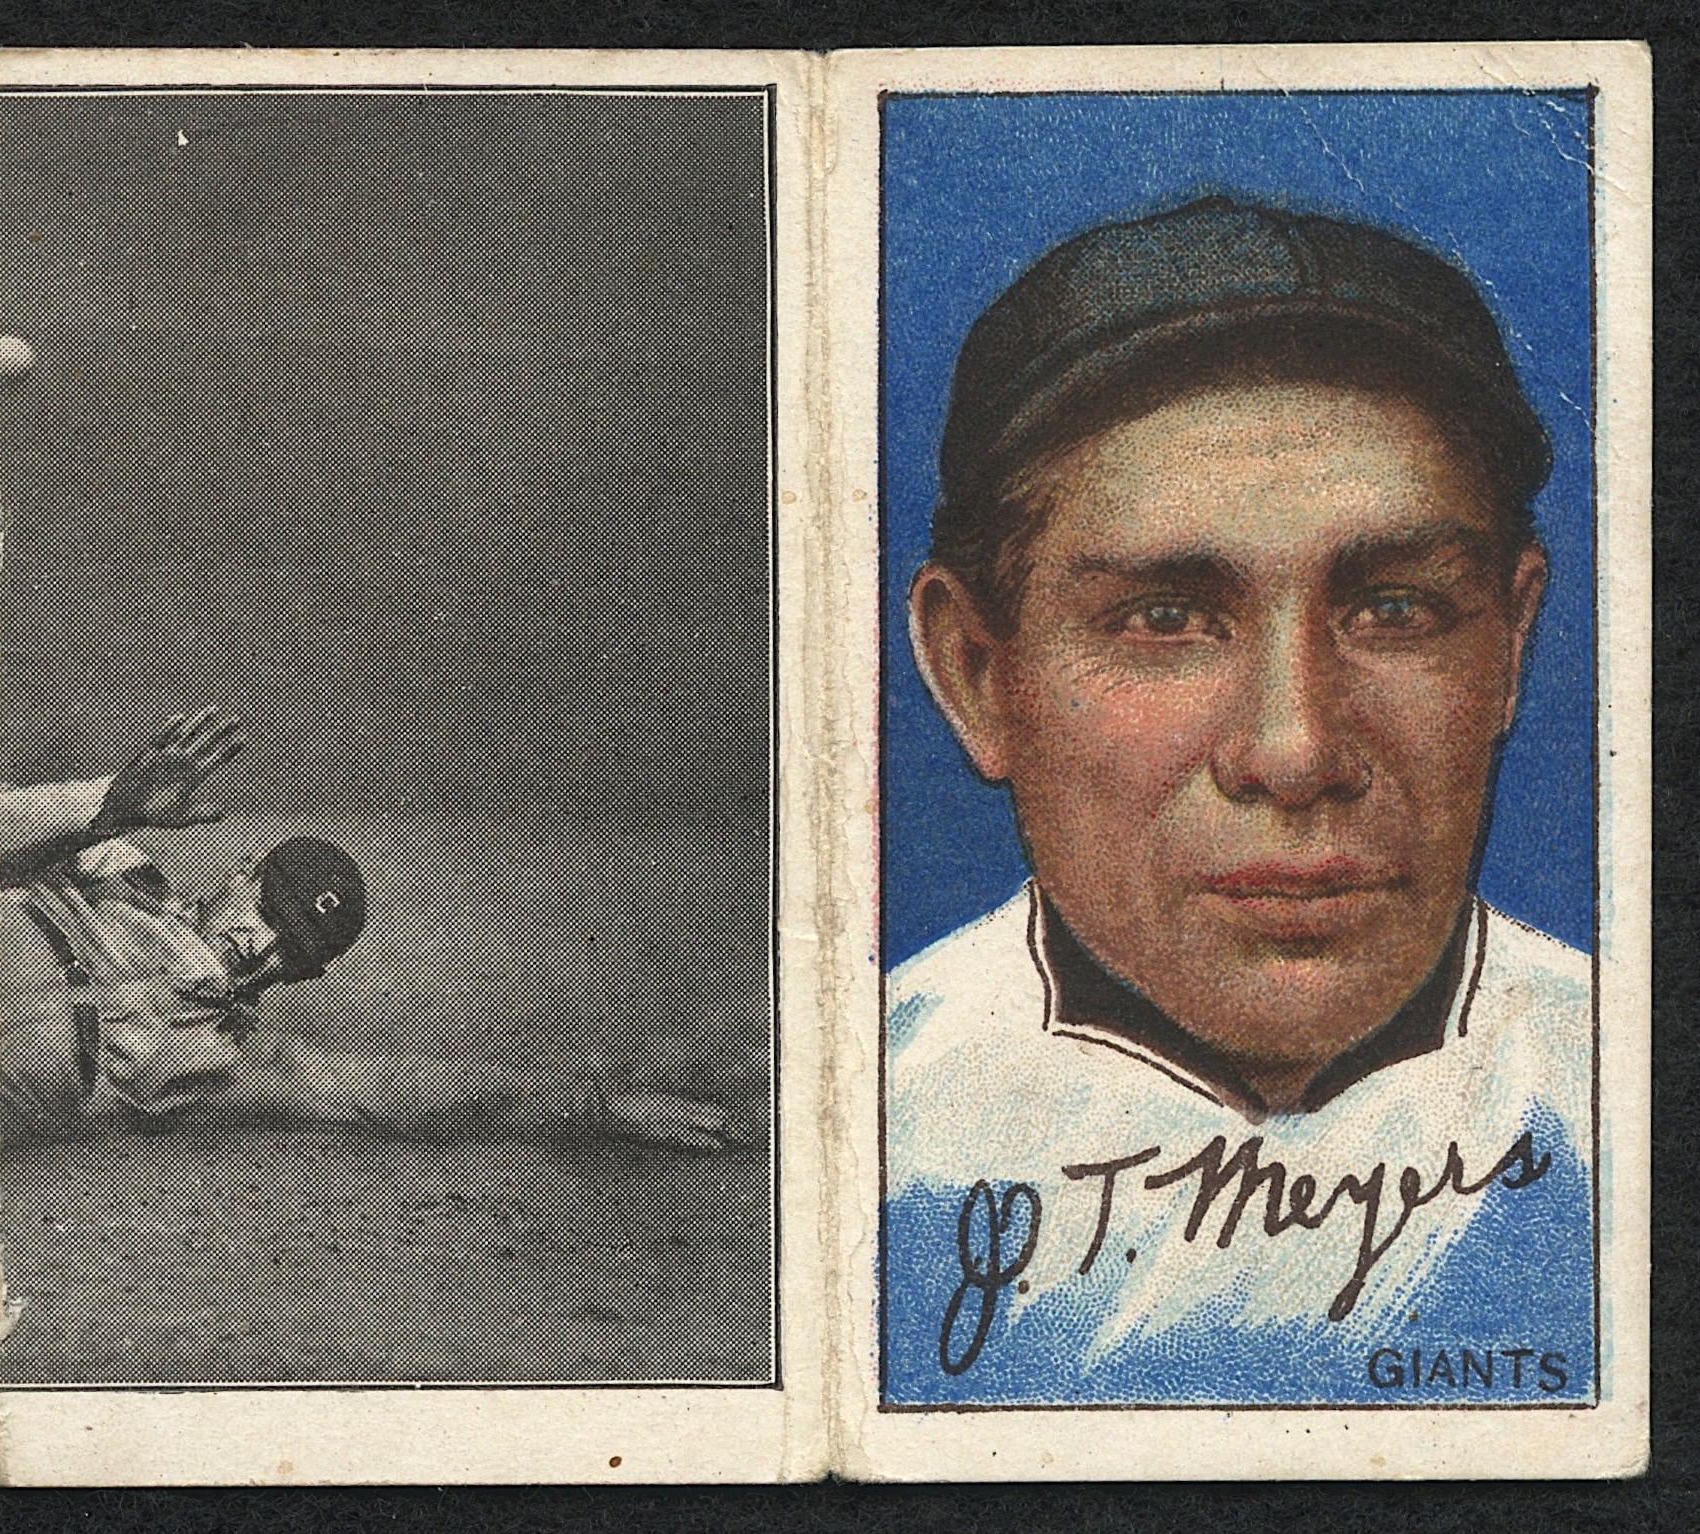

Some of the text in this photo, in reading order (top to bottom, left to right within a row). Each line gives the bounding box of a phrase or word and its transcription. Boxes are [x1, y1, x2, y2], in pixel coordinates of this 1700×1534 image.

[315, 891, 341, 914] C
[1061, 1145, 1162, 1275] T.
[1145, 1134, 1551, 1322] Meyers
[1367, 1347, 1568, 1393] GIANTS
